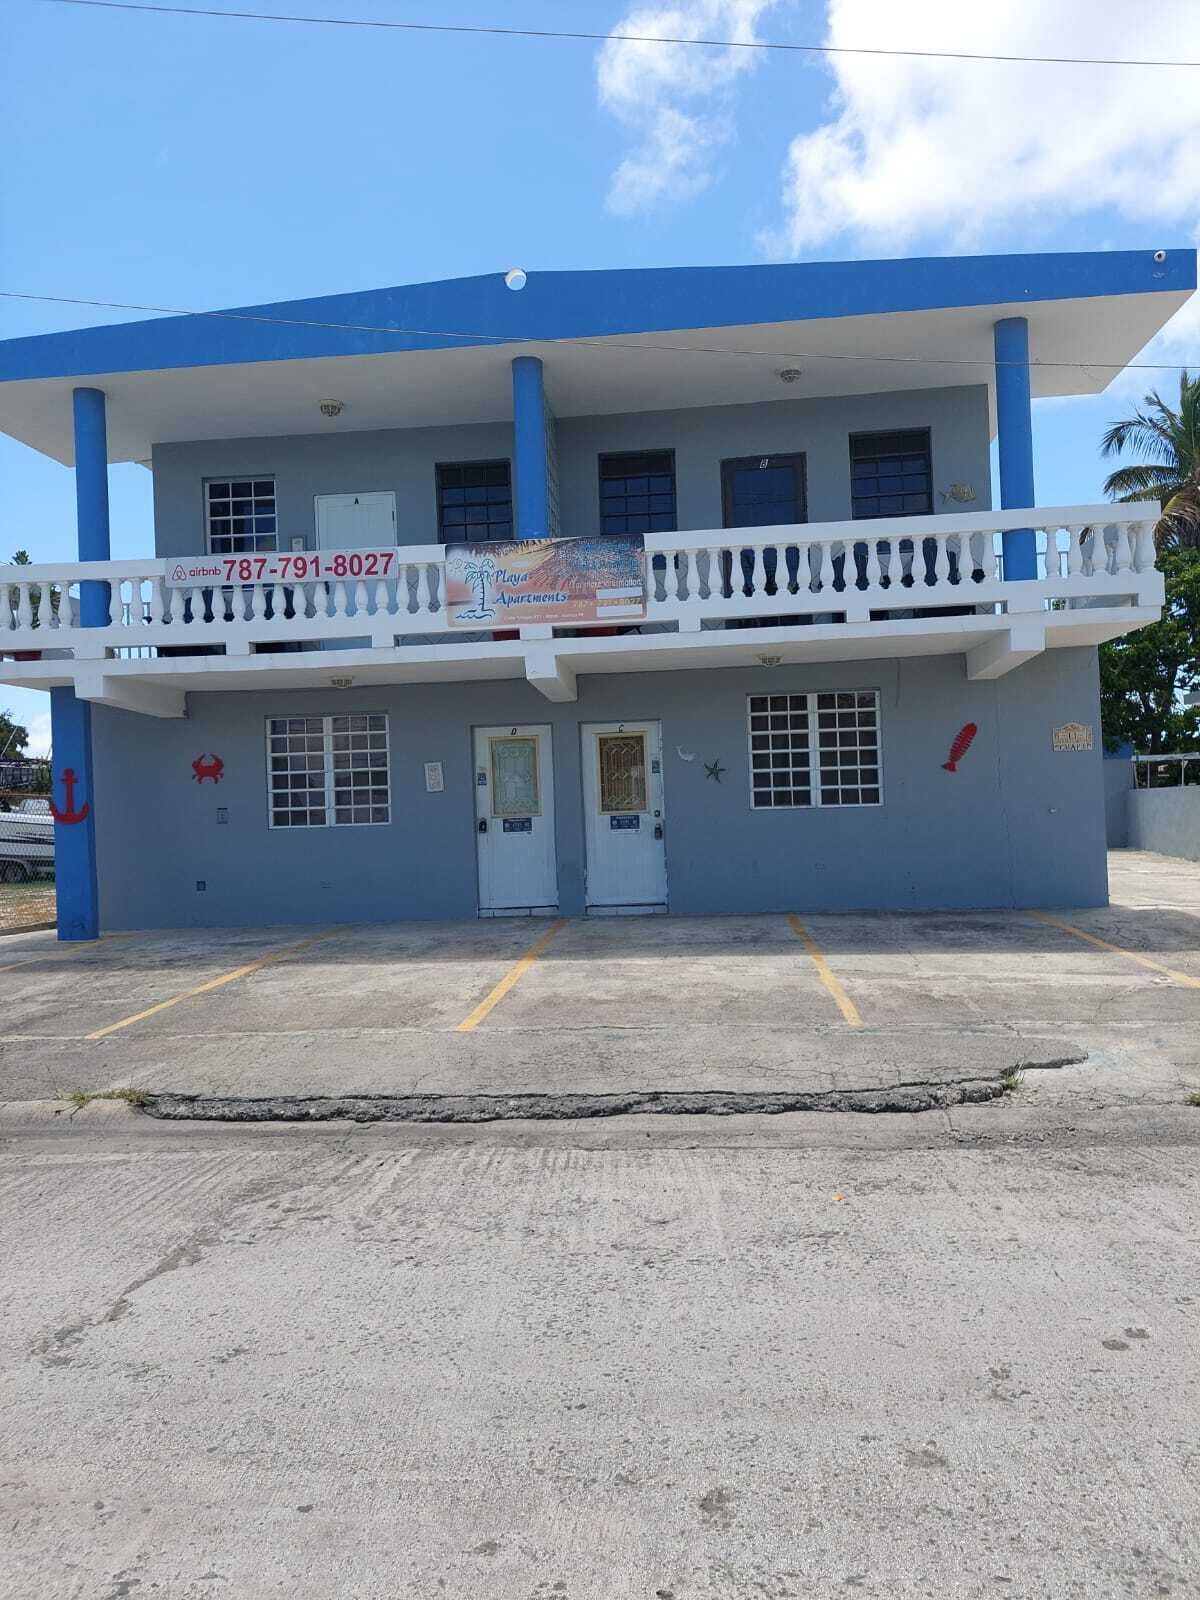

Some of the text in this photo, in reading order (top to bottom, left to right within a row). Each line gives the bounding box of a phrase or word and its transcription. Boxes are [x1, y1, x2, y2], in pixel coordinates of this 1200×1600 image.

[354, 497, 359, 505] A
[189, 552, 394, 581] airbnb 787-791-8027
[496, 569, 528, 586] Playa
[496, 591, 567, 608] Apartments
